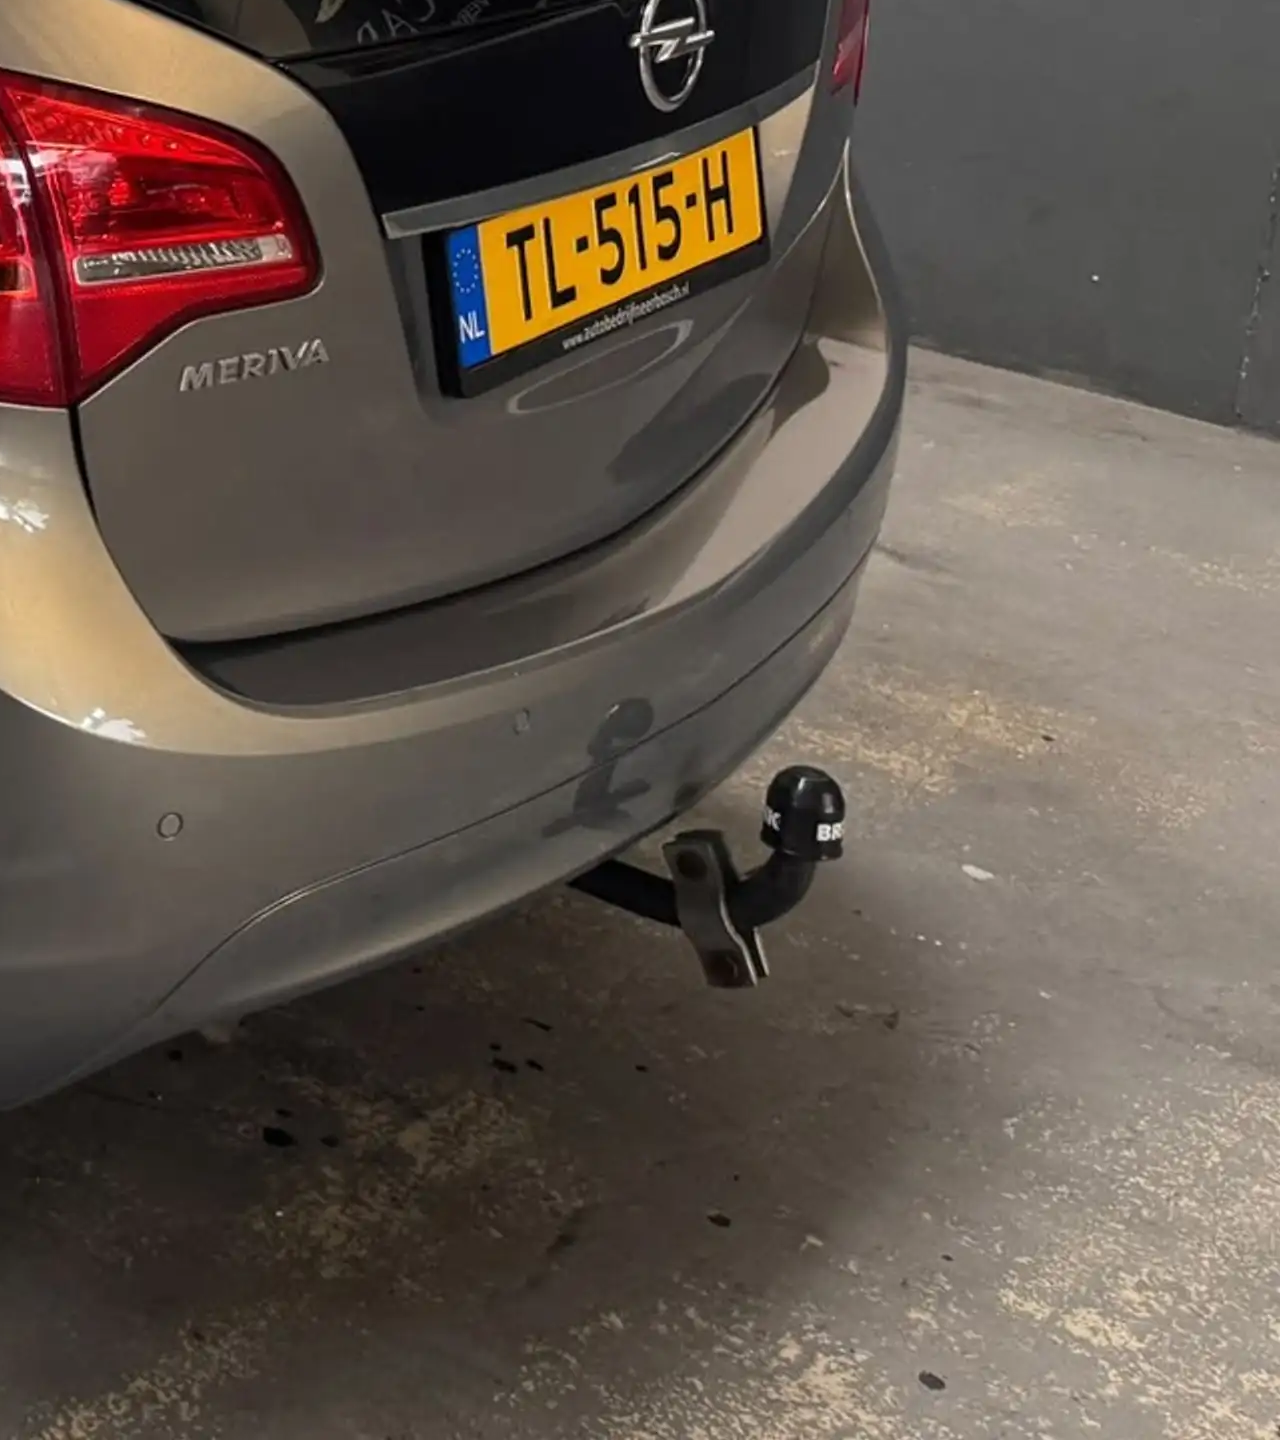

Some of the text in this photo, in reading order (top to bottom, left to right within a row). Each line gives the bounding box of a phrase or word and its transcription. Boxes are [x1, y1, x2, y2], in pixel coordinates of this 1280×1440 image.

[505, 149, 734, 323] TL-515-H
[458, 311, 486, 345] NL
[178, 338, 331, 392] MERIVA
